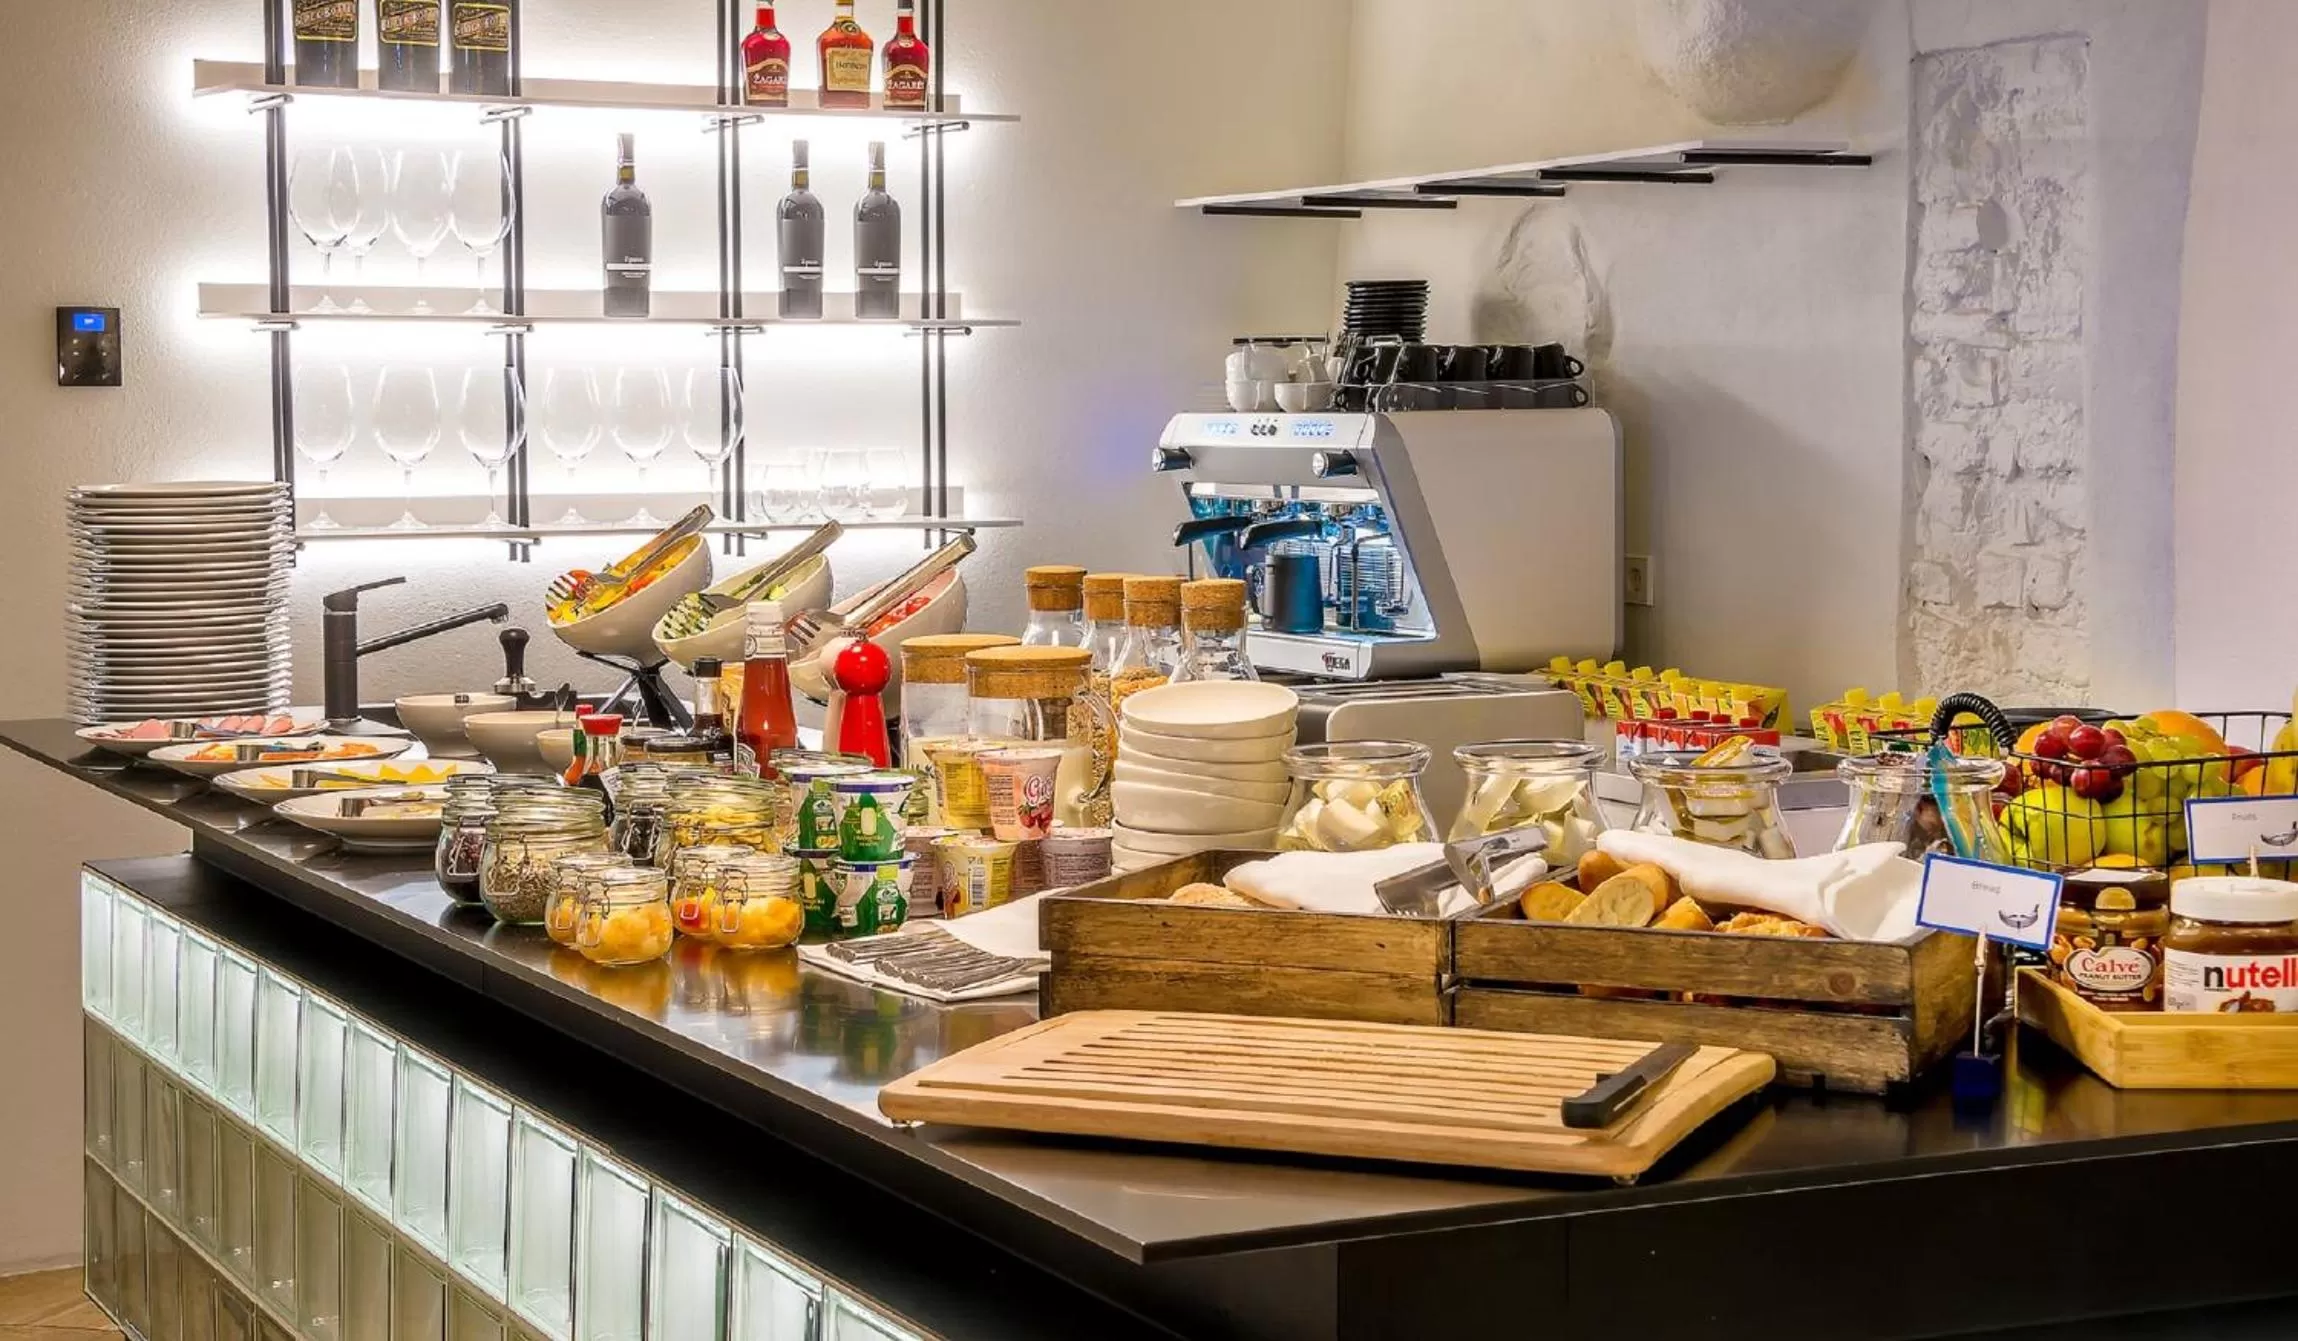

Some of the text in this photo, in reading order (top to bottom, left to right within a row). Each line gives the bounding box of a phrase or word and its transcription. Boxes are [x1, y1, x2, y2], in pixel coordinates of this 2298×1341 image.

[2080, 972, 2142, 980] PEANUT BUTTER
[2204, 958, 2298, 988] nutell
